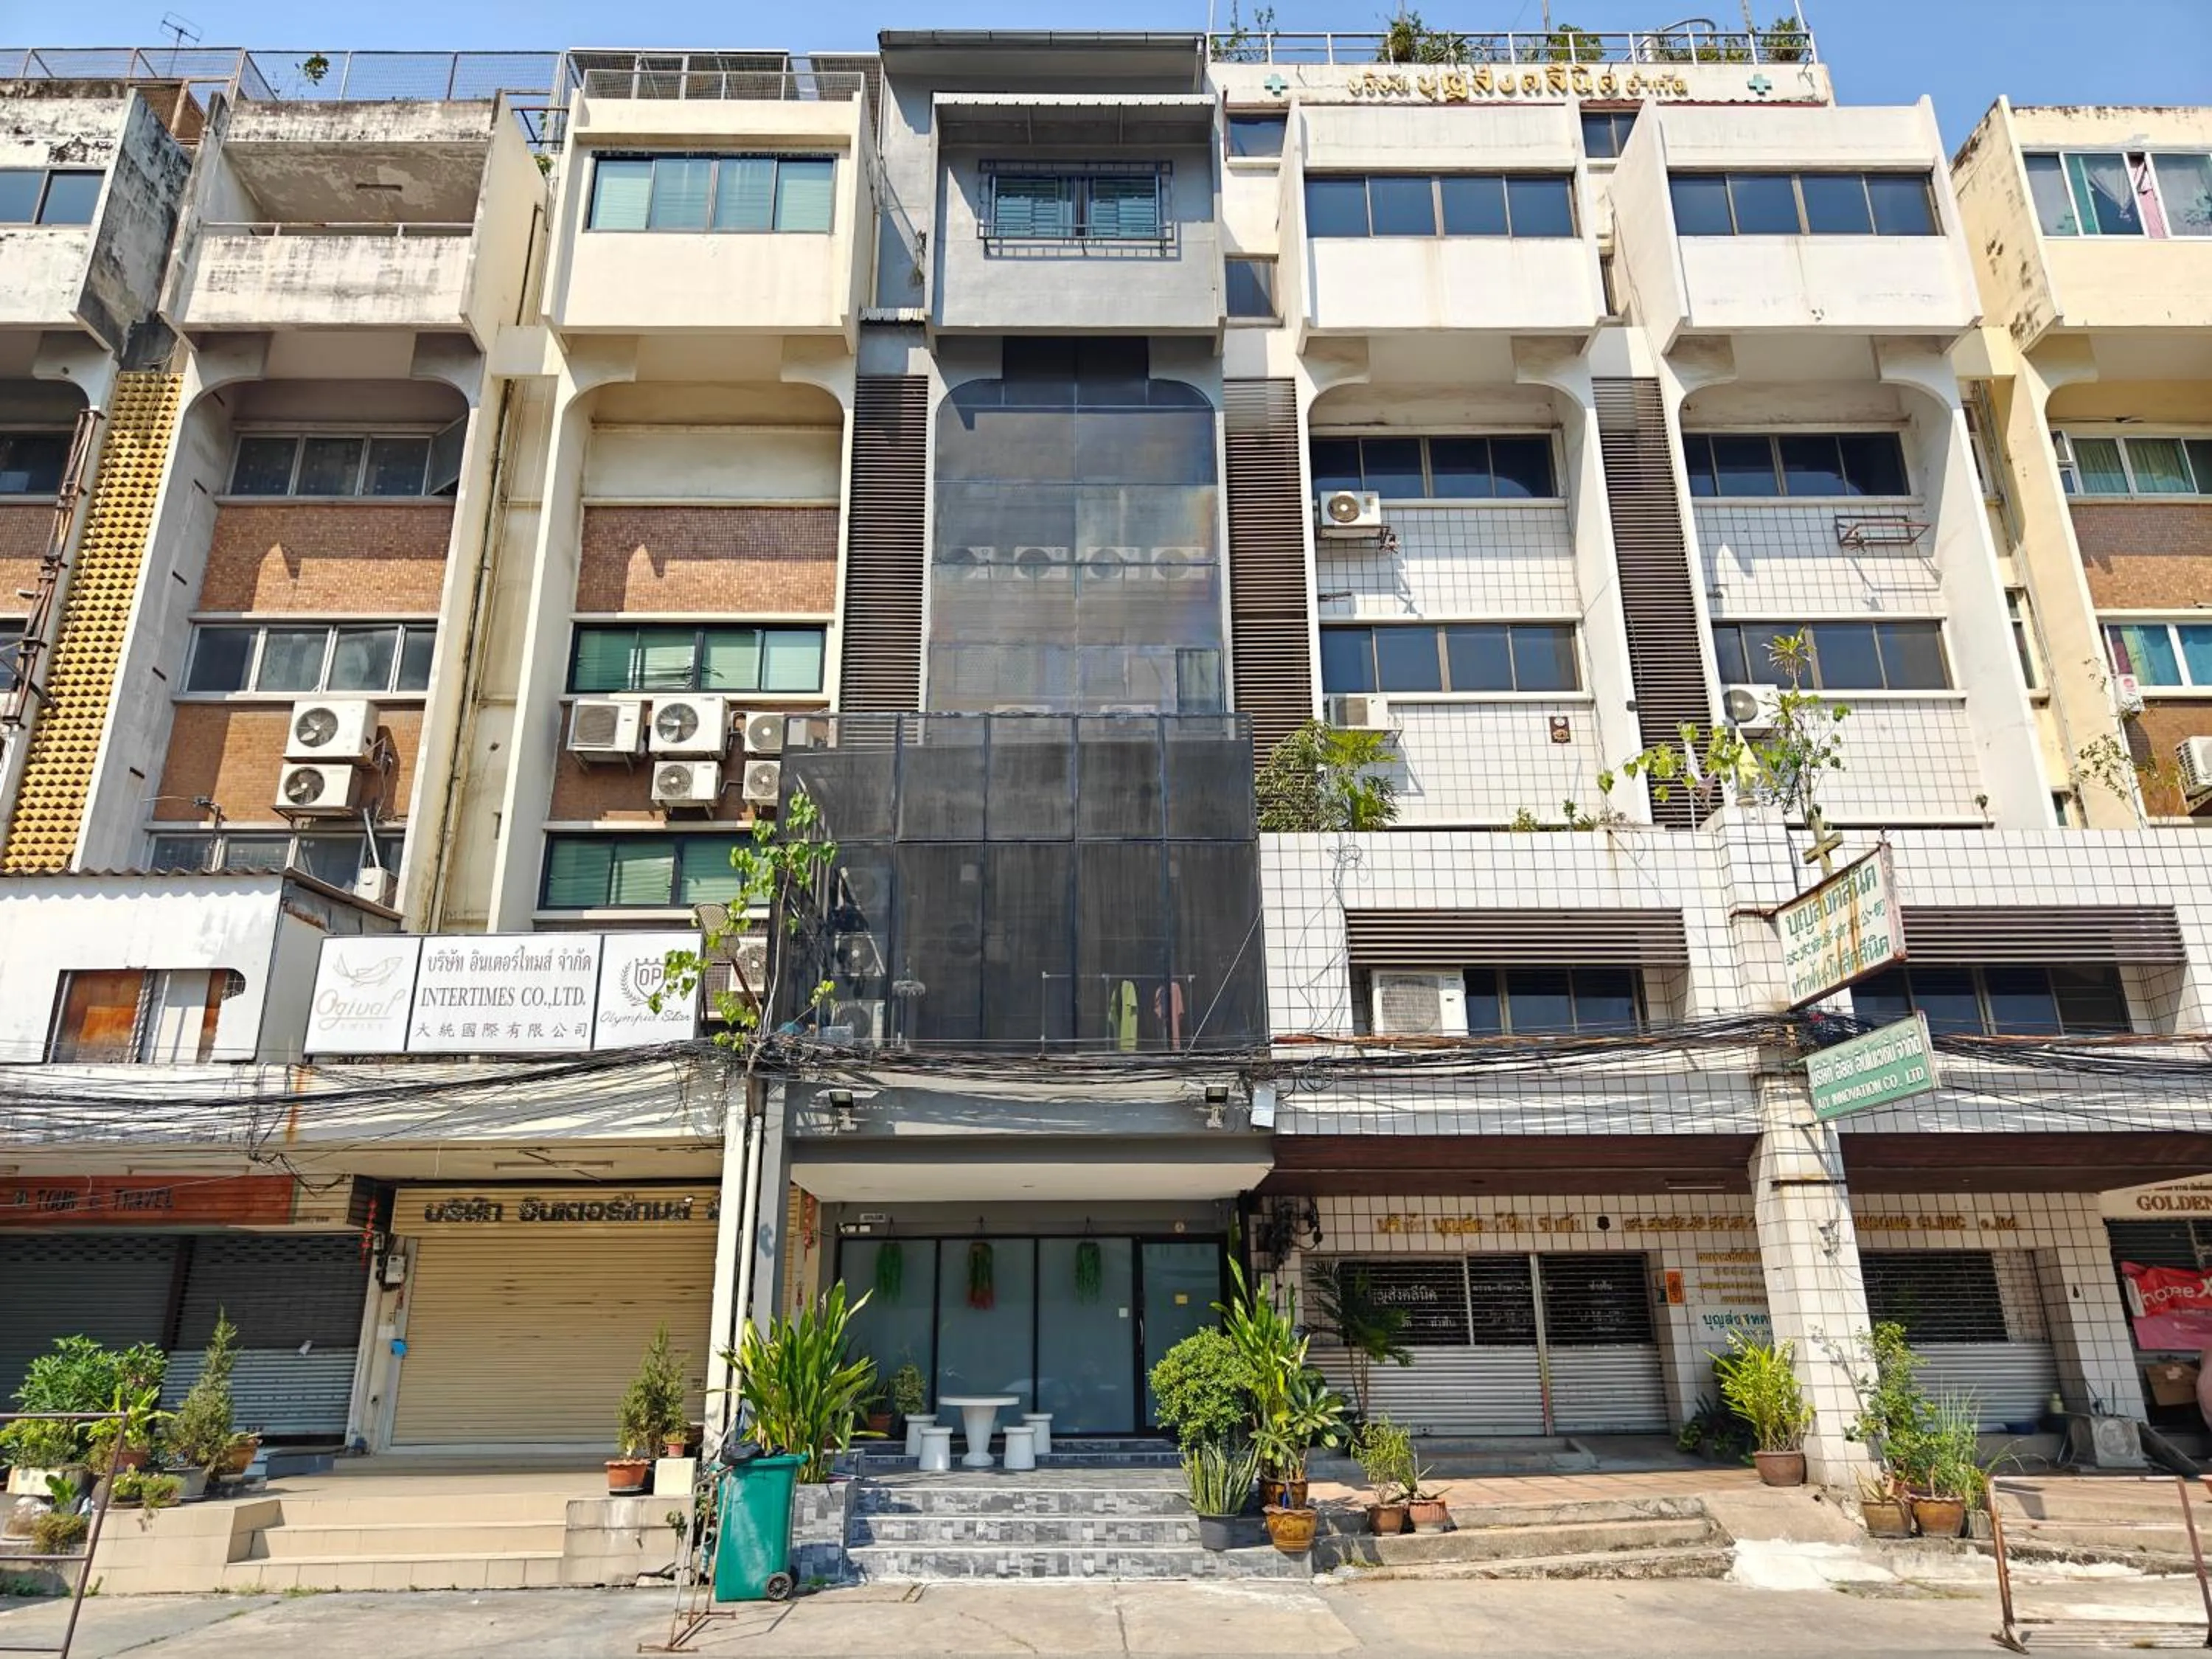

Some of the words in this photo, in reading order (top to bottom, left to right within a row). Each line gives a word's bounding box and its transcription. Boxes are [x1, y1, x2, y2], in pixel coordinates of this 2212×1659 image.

[427, 949, 465, 973] บริษัท
[470, 945, 554, 972] อินเตอร์ไทมส์
[557, 947, 592, 972] จำกัด
[639, 968, 661, 987] OP
[316, 989, 406, 1030] Ogival
[420, 987, 516, 1007] INTERTIMES
[521, 987, 586, 1009] CO.,LTD.
[1832, 1079, 1882, 1105] INNOVATION
[425, 1197, 504, 1222] บริษัท
[2136, 1194, 2212, 1211] GOLDEN
